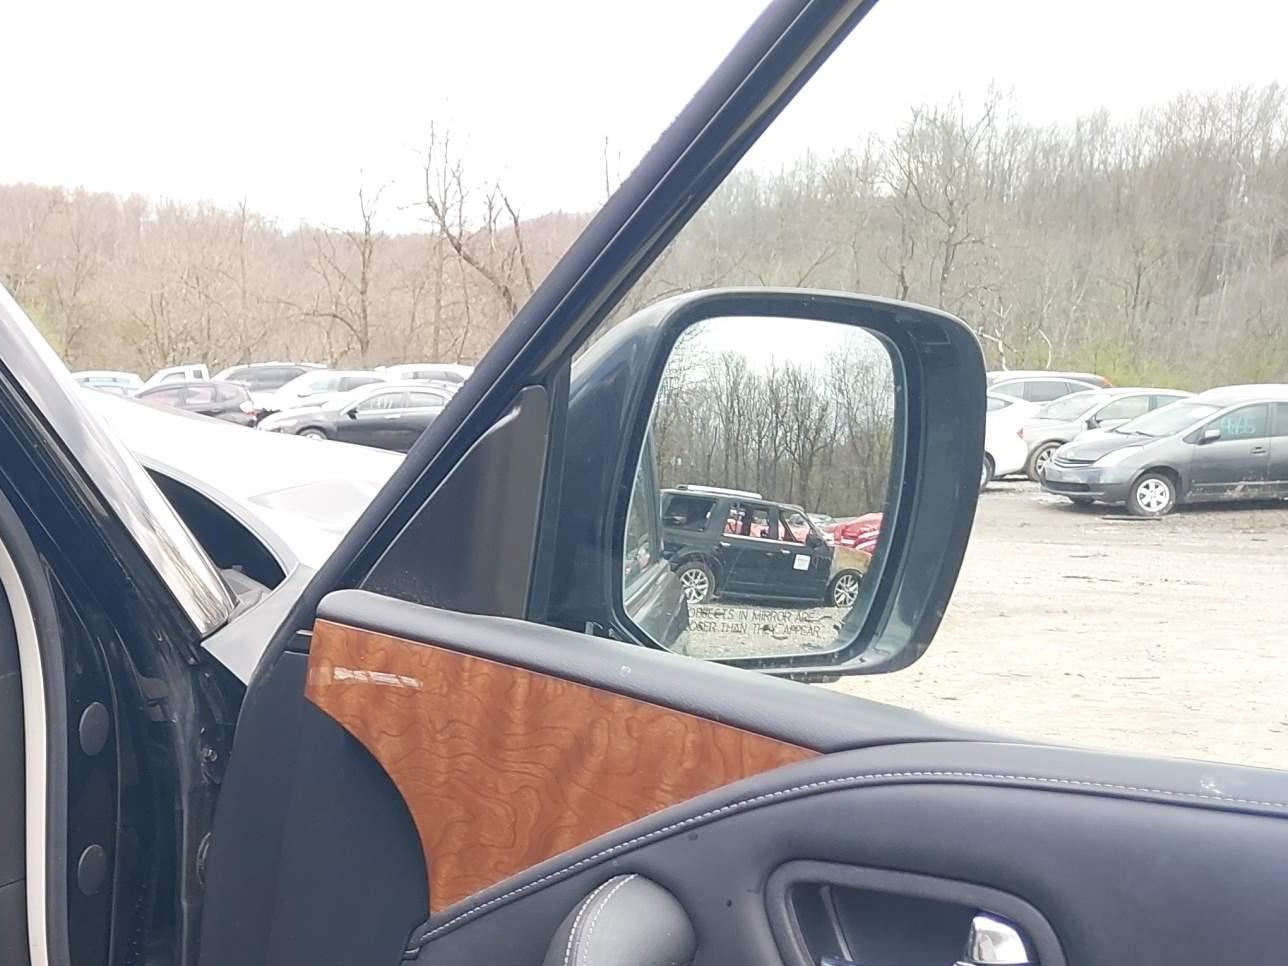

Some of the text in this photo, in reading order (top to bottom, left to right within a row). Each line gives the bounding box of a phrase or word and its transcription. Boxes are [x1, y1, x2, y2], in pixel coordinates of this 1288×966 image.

[736, 608, 748, 621] IN
[751, 609, 792, 622] MIRROR
[720, 621, 747, 634] THAN
[783, 624, 821, 637] APPEAR
